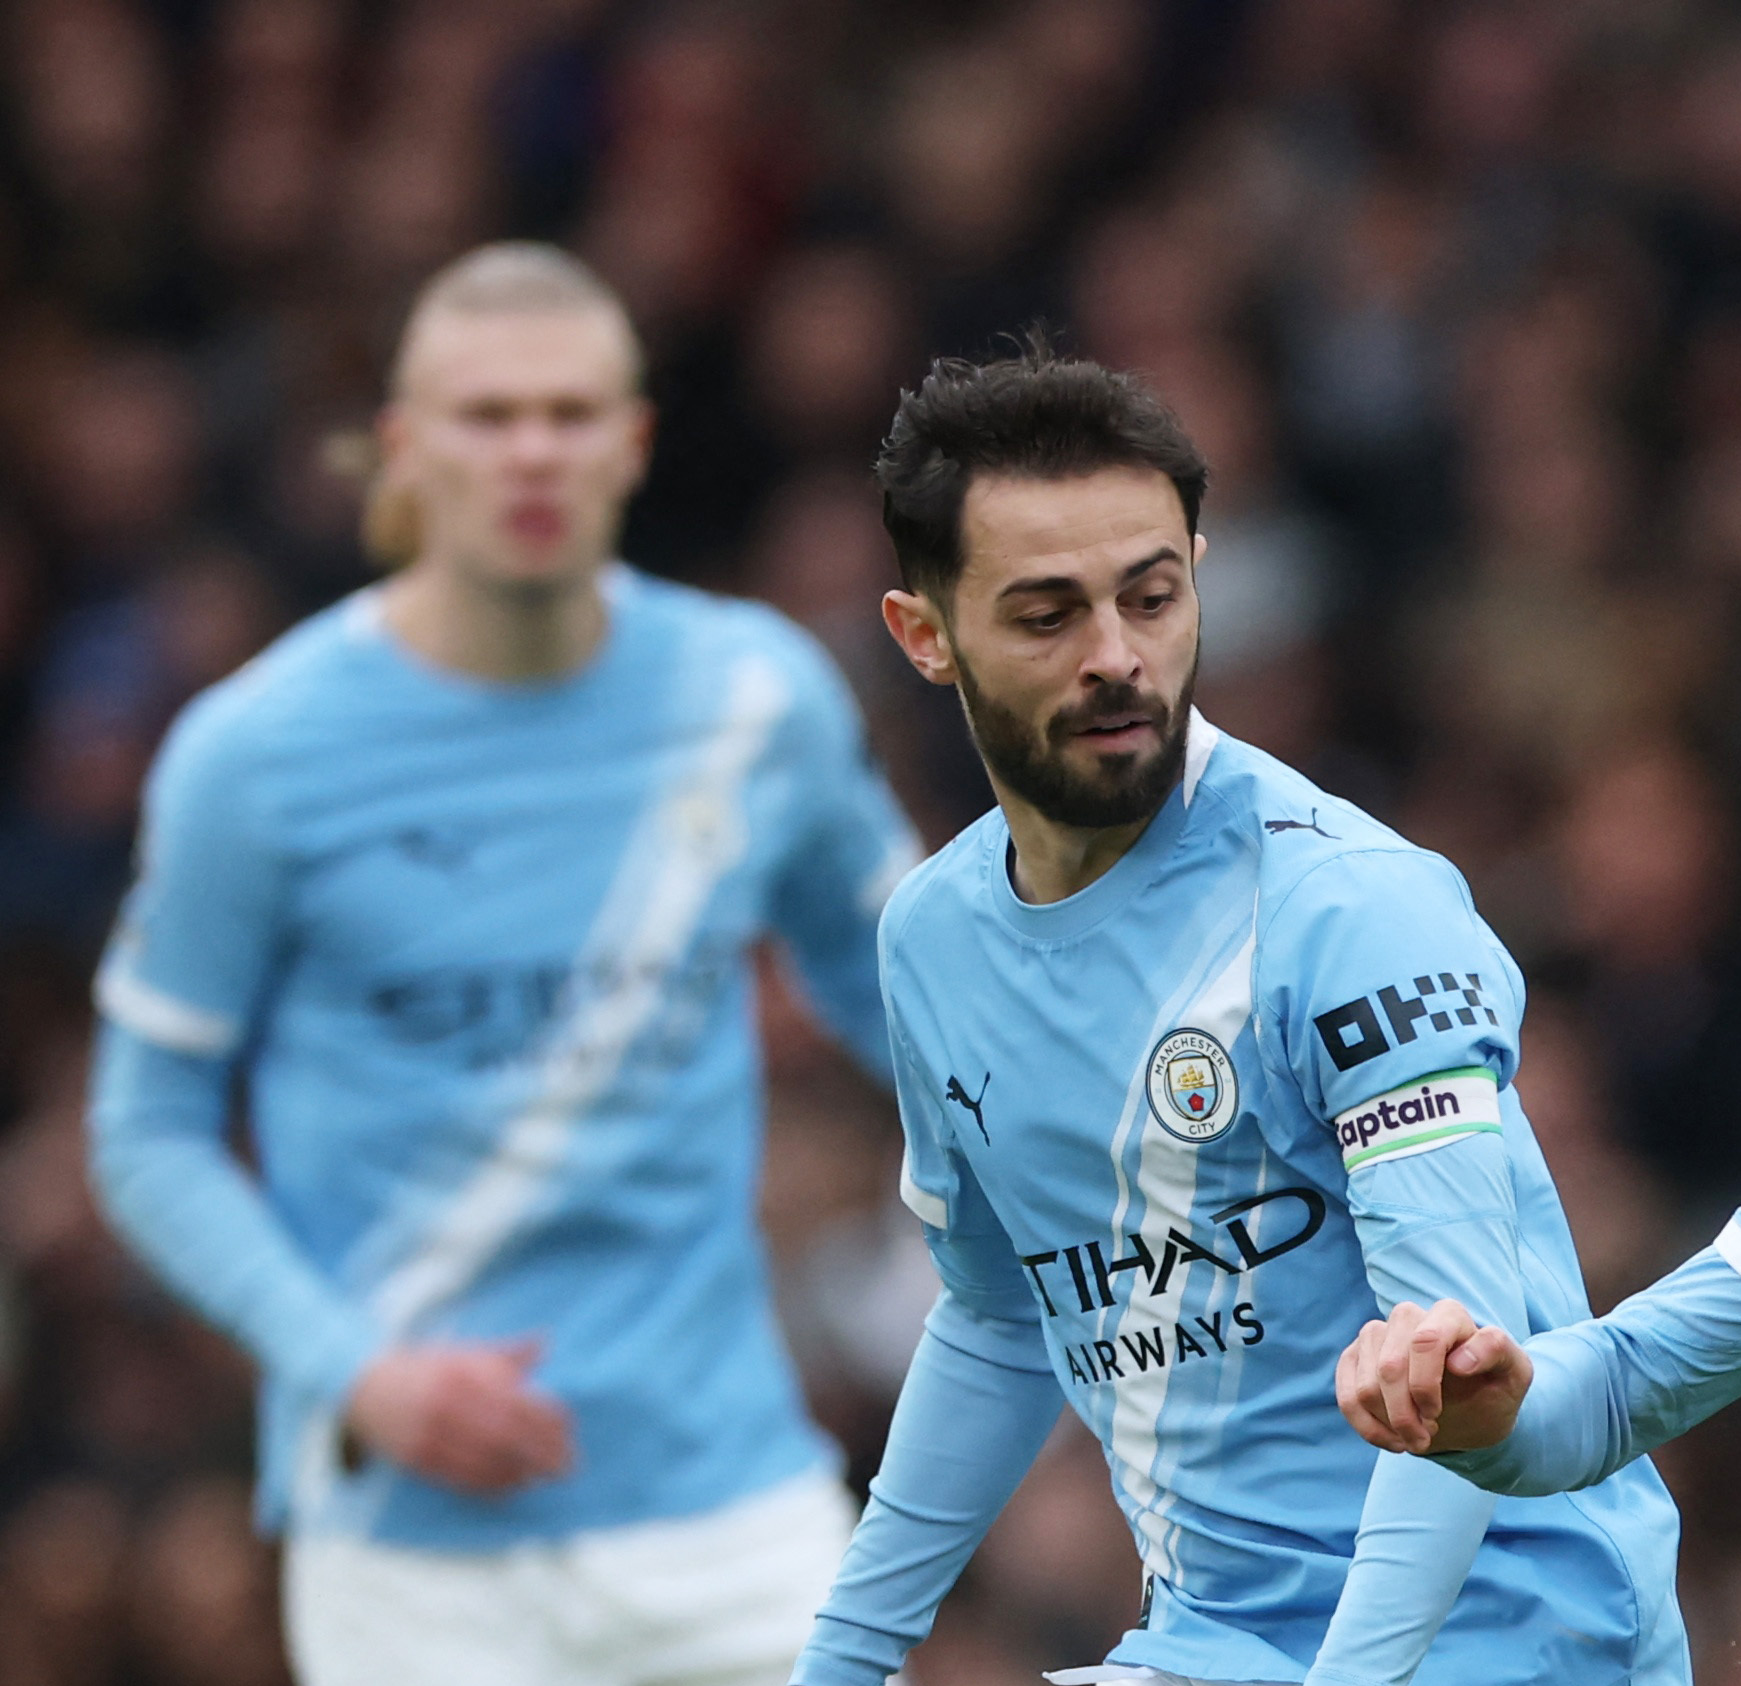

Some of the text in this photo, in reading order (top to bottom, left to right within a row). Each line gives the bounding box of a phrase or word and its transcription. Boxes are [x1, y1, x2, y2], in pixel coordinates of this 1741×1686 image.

[1155, 1037, 1225, 1077] MANCHESTER
[1188, 1122, 1215, 1135] CITY
[1020, 1187, 1326, 1317] TIHAD
[1065, 1302, 1264, 1385] AIRWAYS
